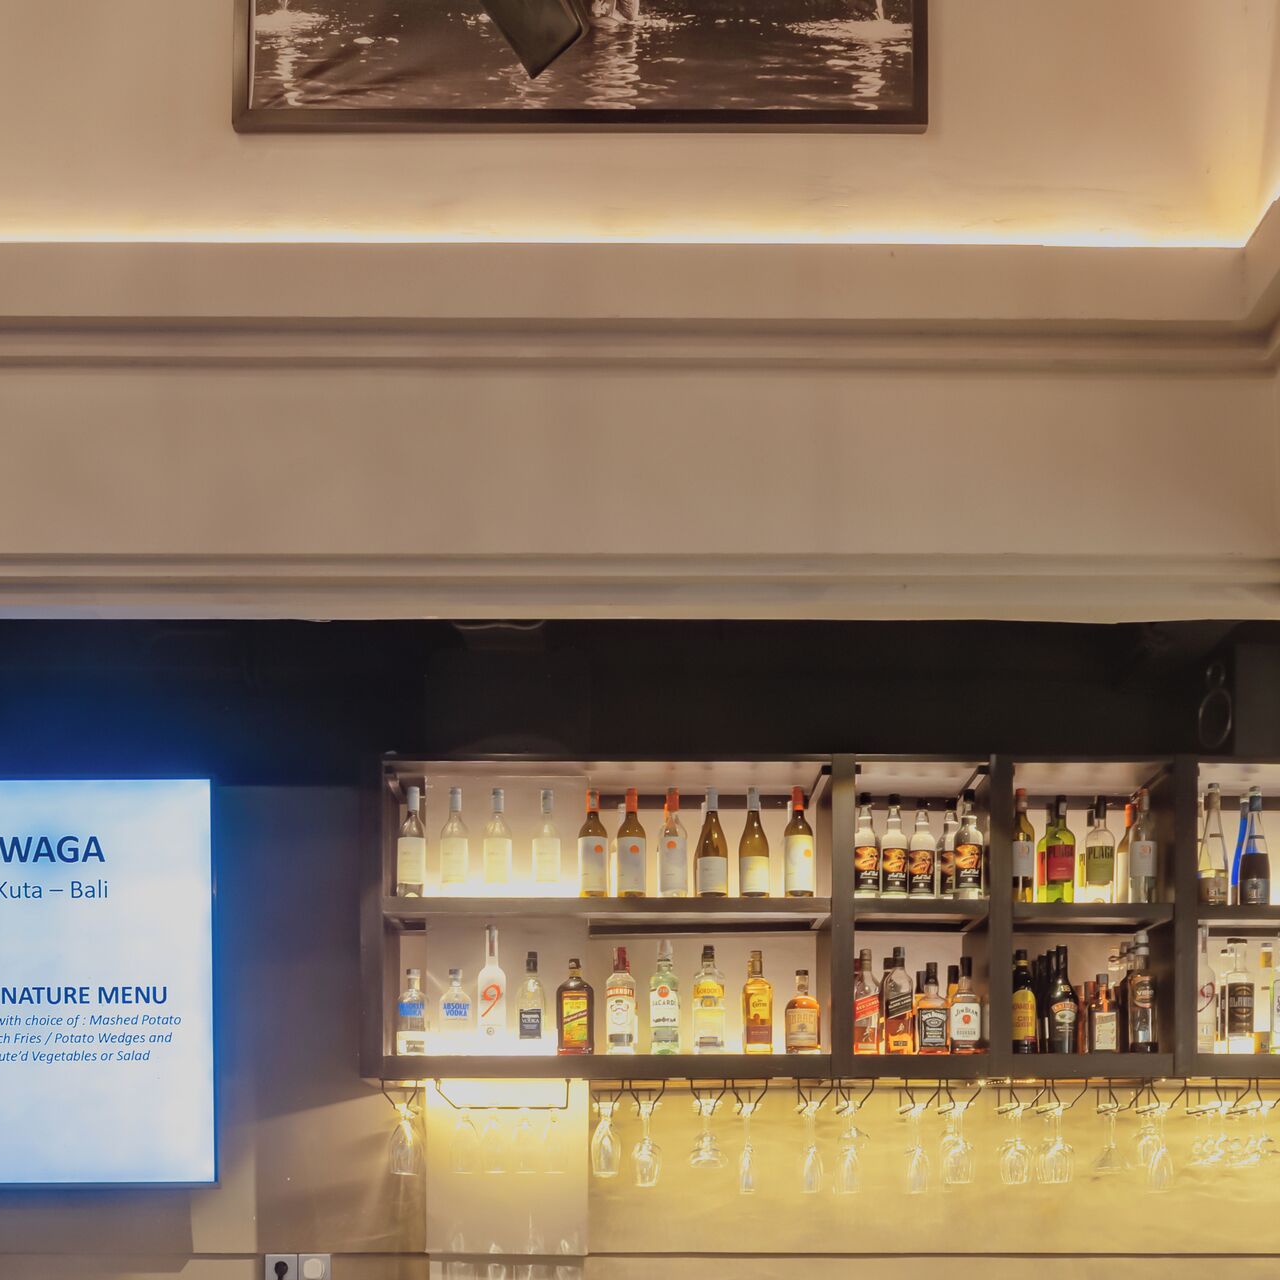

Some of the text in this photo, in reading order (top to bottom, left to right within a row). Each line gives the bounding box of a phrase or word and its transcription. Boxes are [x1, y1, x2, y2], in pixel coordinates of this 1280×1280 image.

[71, 879, 108, 899] Bali
[98, 986, 168, 1005] MENU
[25, 1015, 63, 1026] choice
[66, 1014, 80, 1028] of
[89, 1014, 139, 1026] Mashed
[141, 1014, 181, 1025] Potato
[13, 1033, 42, 1044] Fries
[55, 1033, 95, 1044] Potato
[98, 1032, 146, 1046] Wedges
[149, 1032, 173, 1043] and
[32, 1050, 98, 1064] Vegetables
[100, 1052, 114, 1062] or
[116, 1050, 151, 1061] Salad
